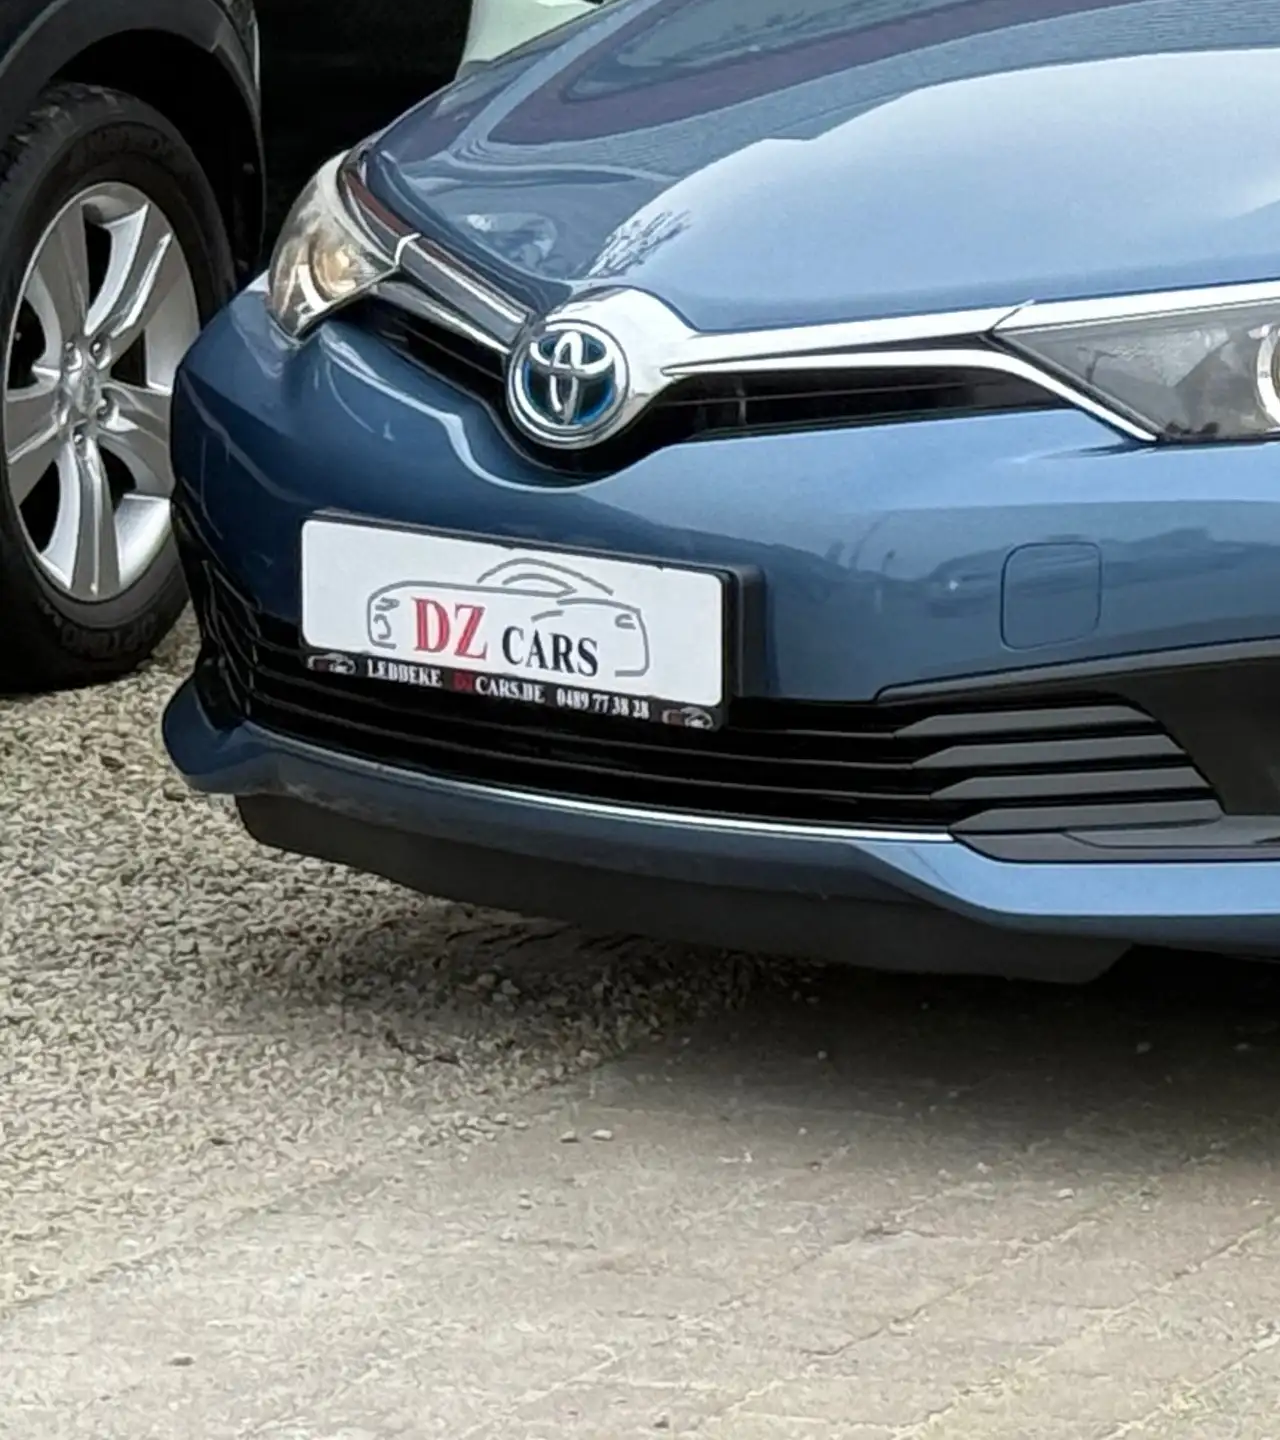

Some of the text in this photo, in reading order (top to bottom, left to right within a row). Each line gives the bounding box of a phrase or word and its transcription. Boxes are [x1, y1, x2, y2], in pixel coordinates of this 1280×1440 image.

[412, 596, 600, 678] DZ CARS
[591, 692, 610, 714] 77
